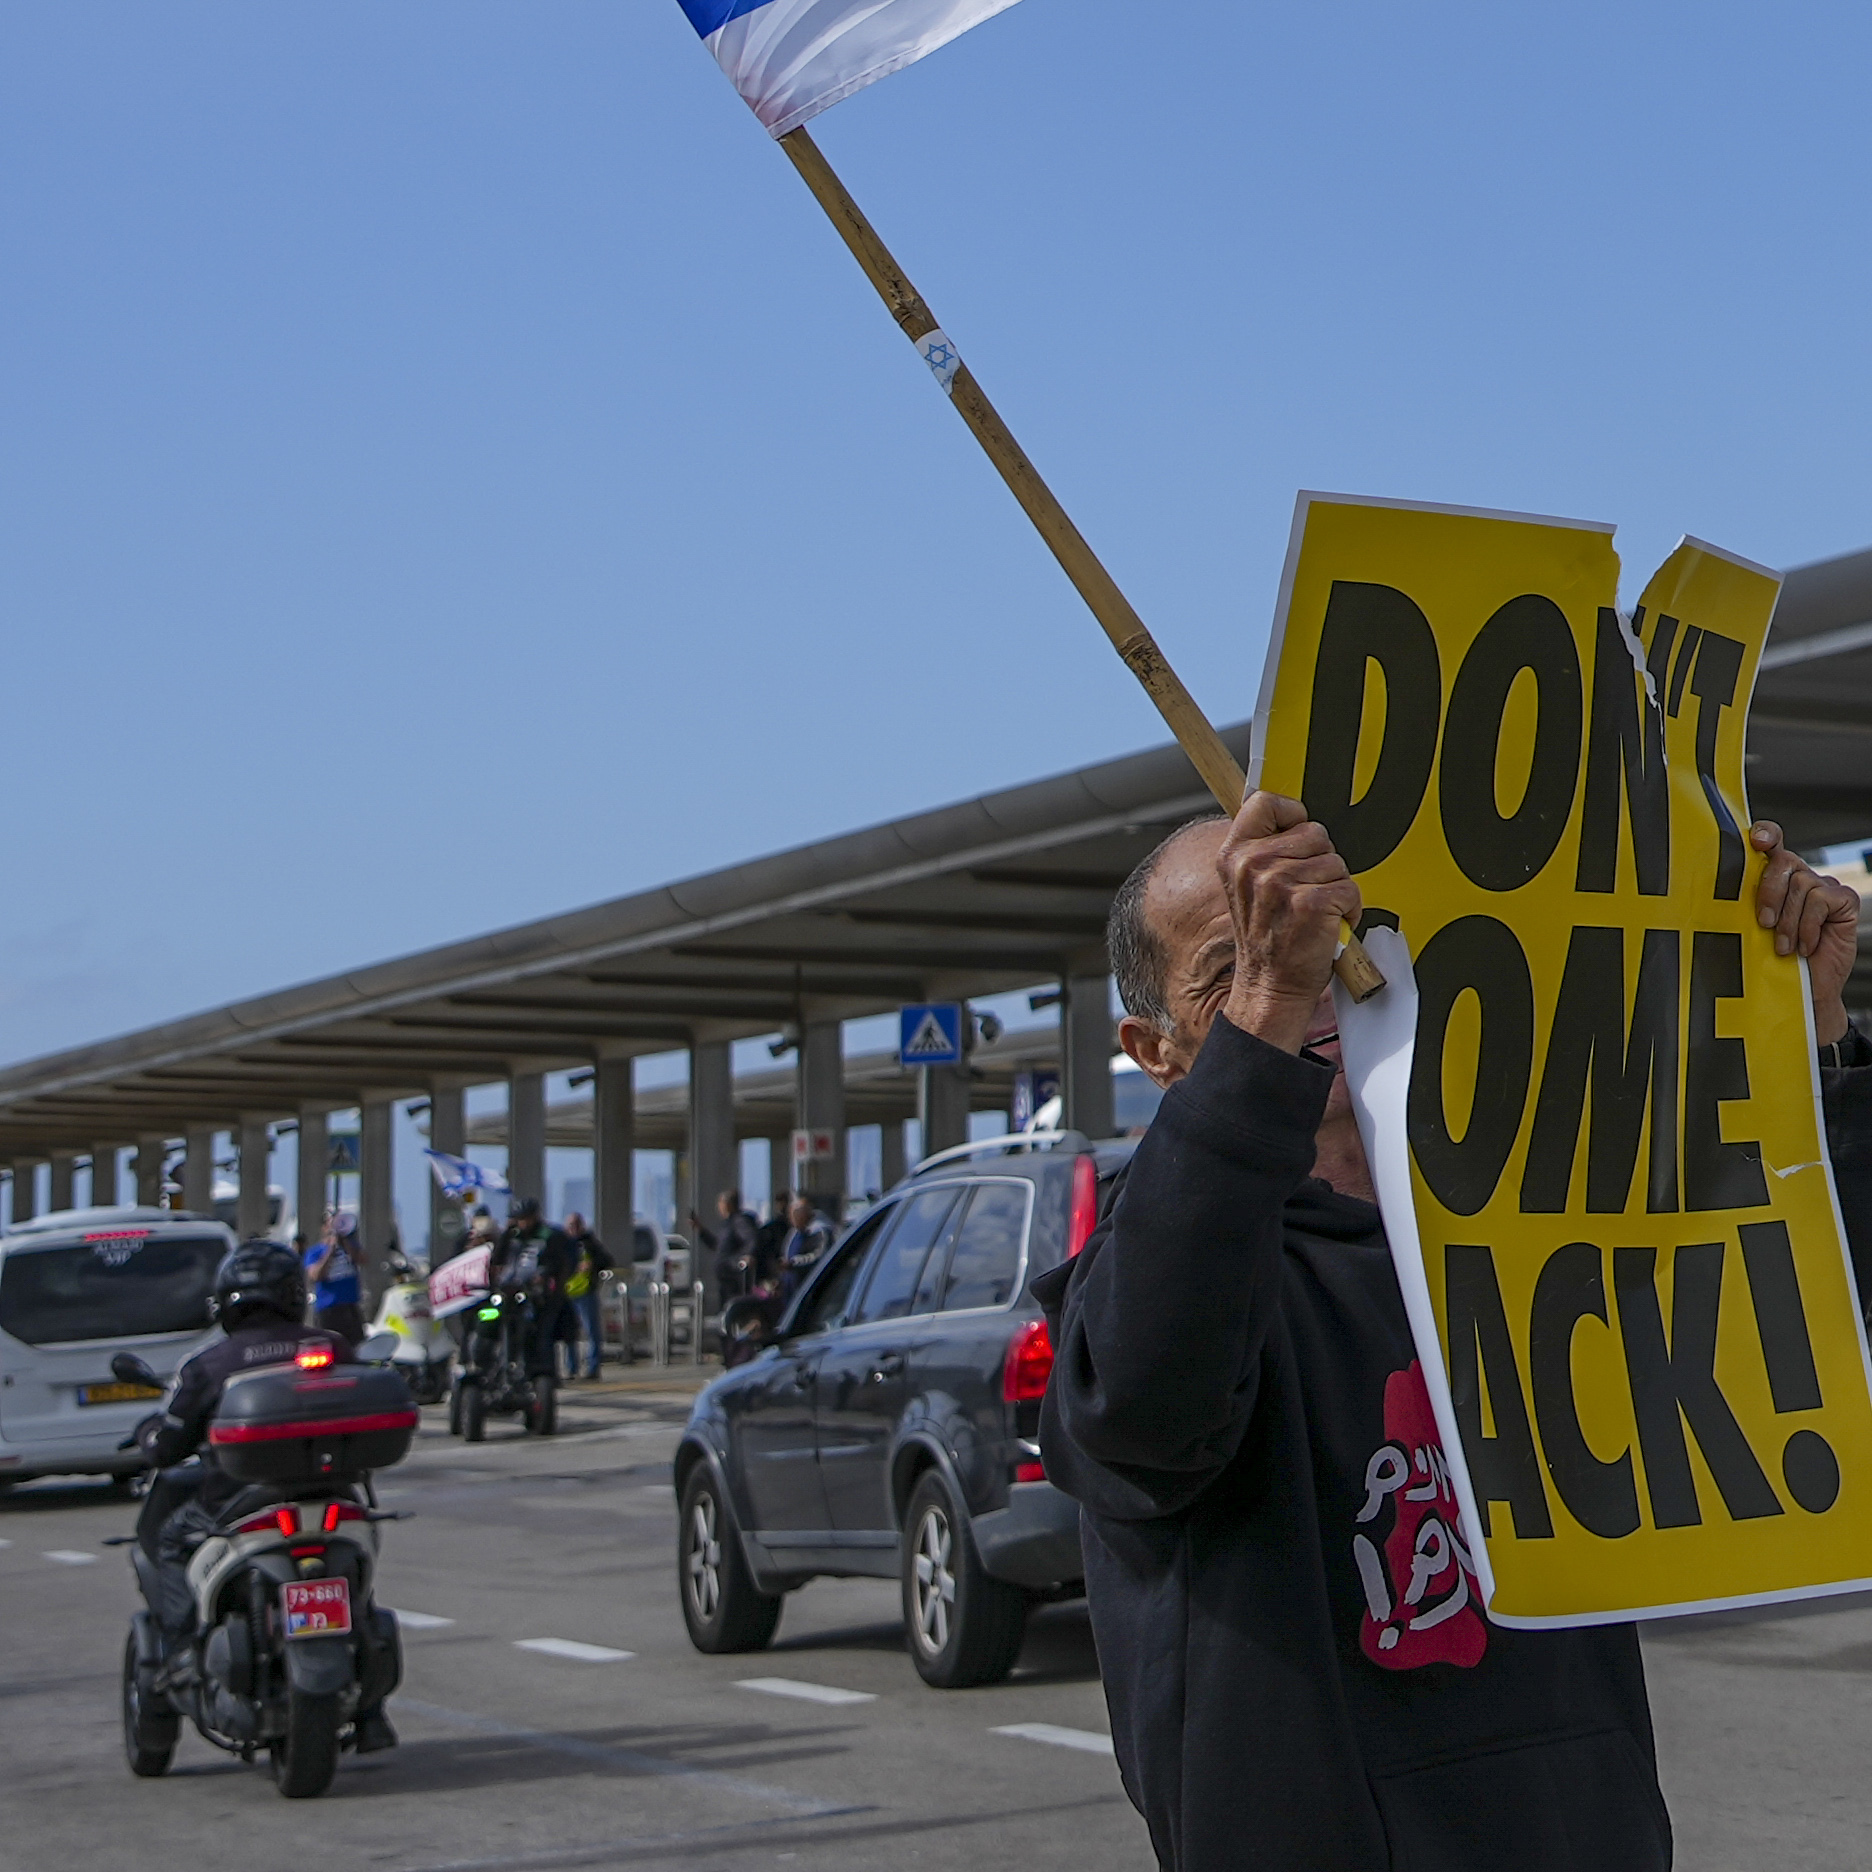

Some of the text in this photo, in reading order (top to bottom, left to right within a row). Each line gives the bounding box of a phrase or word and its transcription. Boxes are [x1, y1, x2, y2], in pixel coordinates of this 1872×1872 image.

[1301, 579, 1747, 902] DON'T
[1362, 906, 1772, 1216] OME
[1443, 1219, 1840, 1540] ACK!
